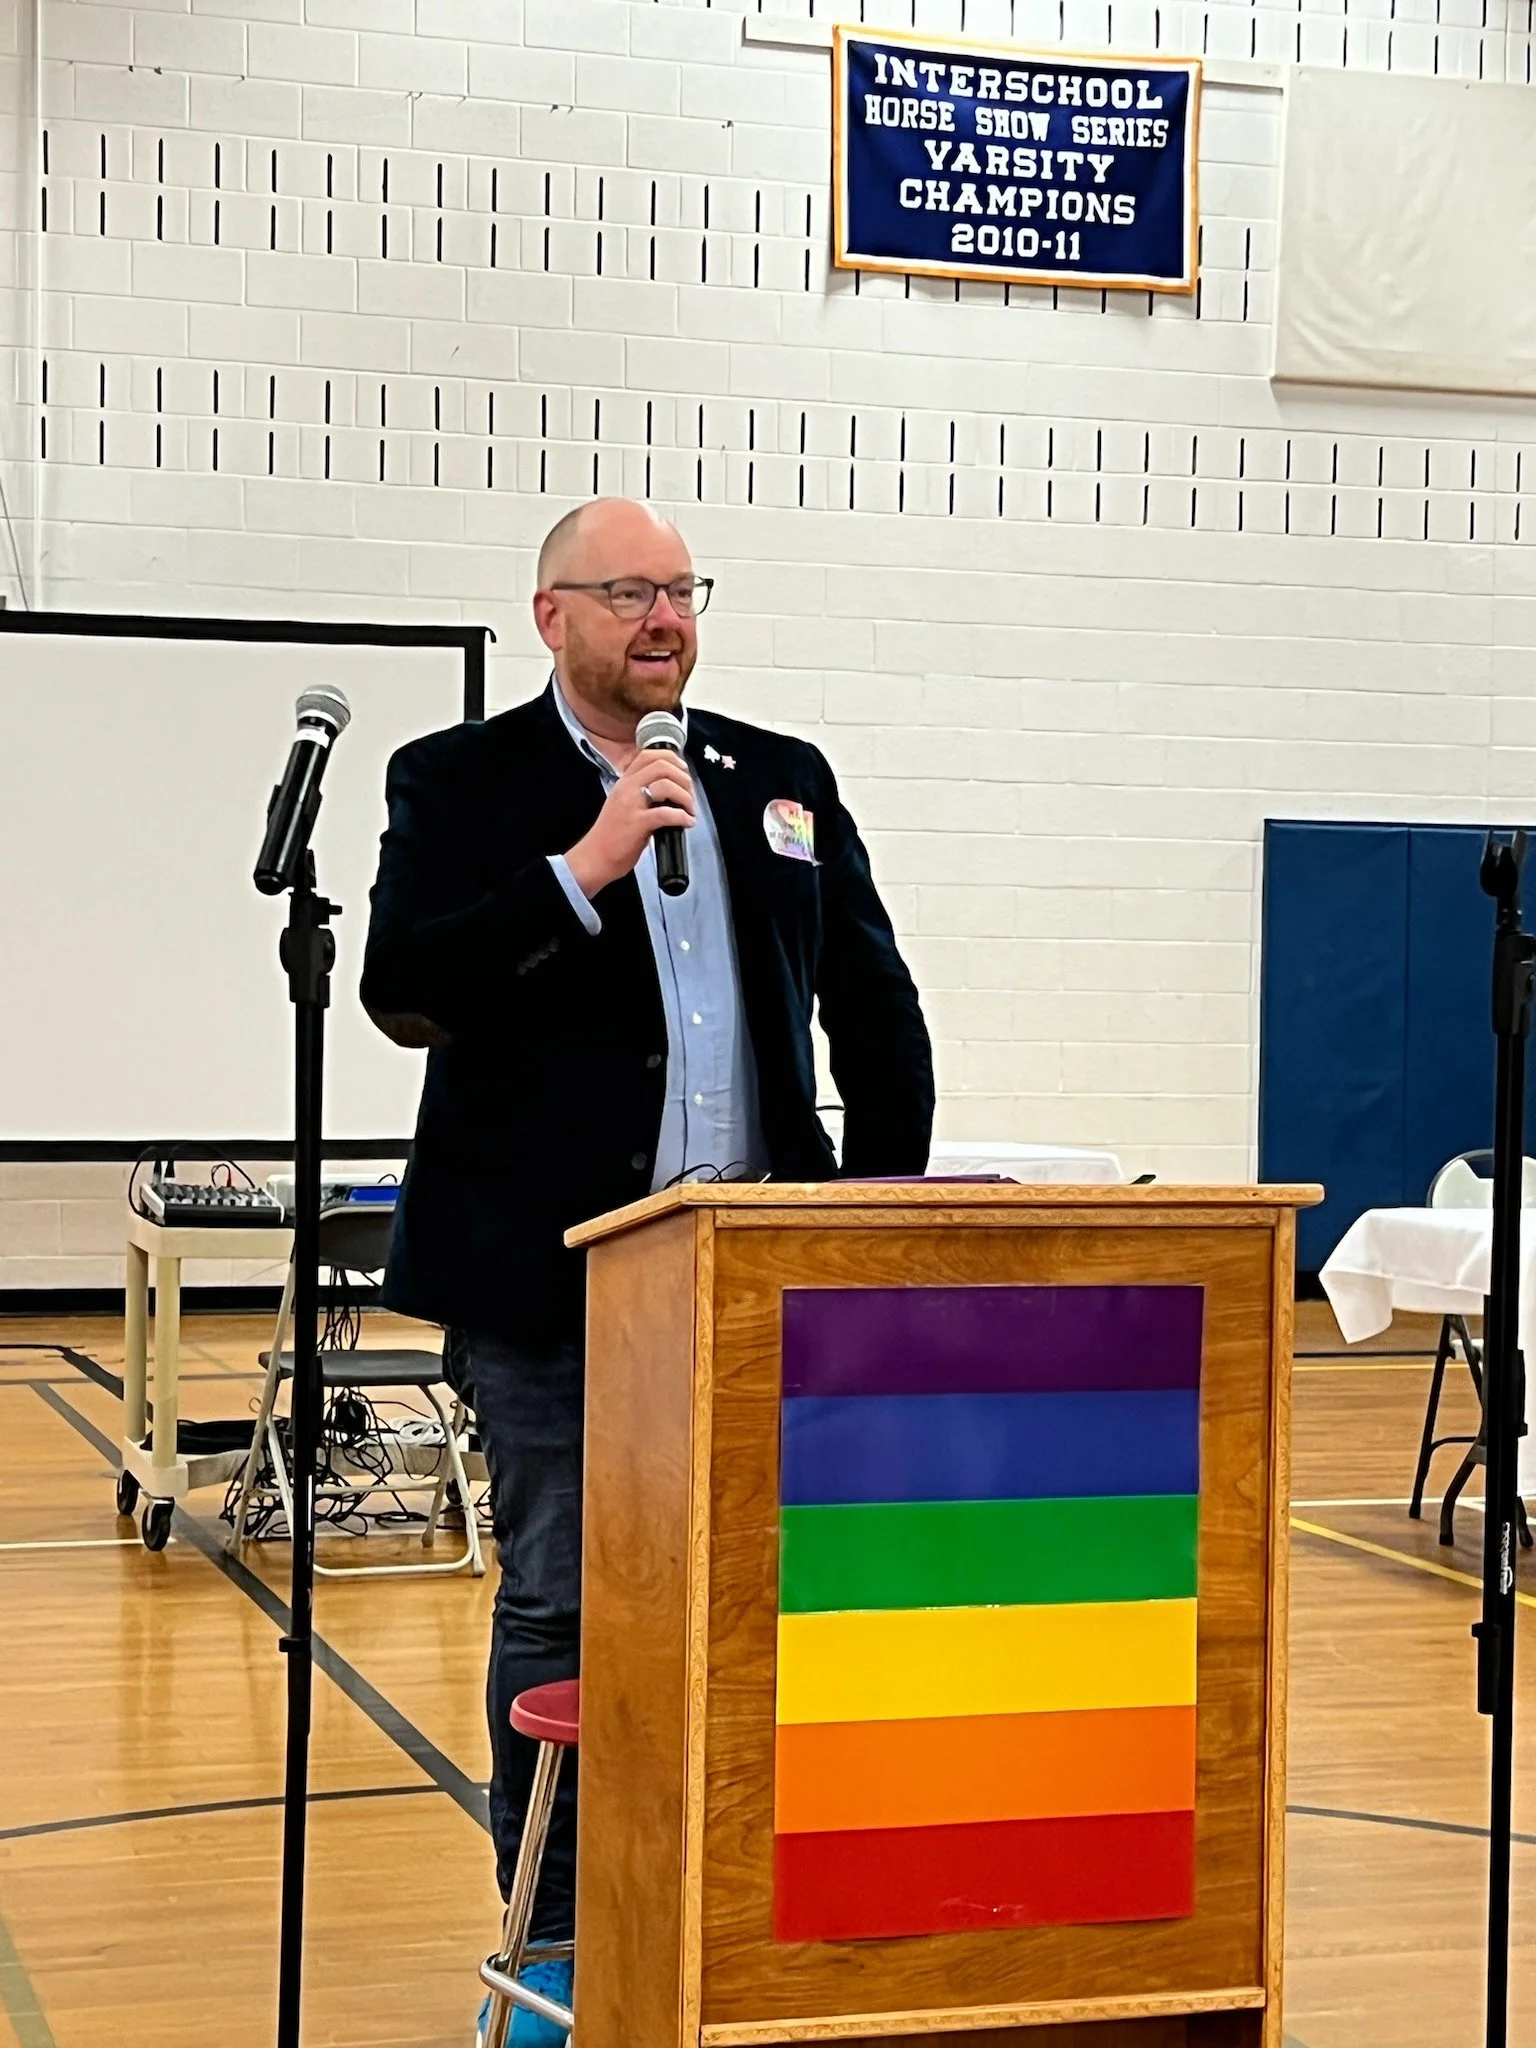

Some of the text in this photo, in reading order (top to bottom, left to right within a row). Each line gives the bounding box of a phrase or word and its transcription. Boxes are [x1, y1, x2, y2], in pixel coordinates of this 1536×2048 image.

[874, 54, 1163, 110] INTERSCHOOL
[865, 94, 1169, 149] HORSE SHOW SERIES
[925, 140, 1115, 183] VARSITY
[900, 179, 1136, 225] CHAMPIONS
[951, 223, 1081, 261] 2010-11
